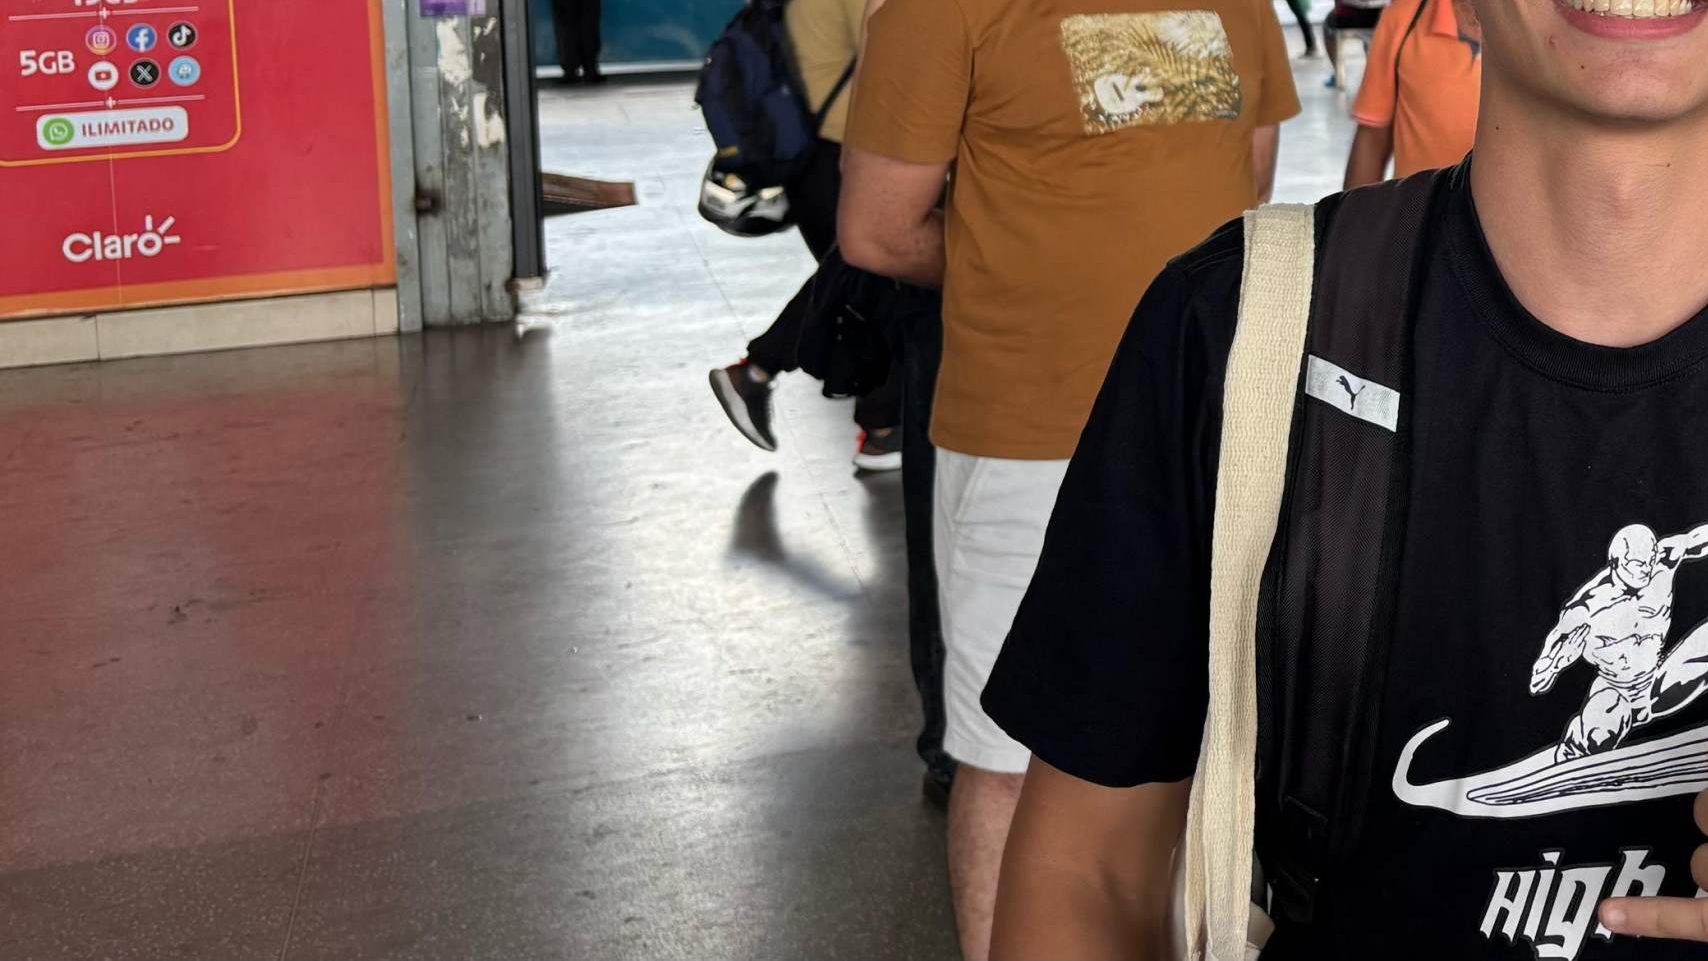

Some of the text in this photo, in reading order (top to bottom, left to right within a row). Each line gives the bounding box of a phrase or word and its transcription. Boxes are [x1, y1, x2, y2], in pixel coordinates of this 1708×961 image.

[19, 49, 76, 77] 5GB
[81, 116, 175, 138] ILIMITADO
[62, 220, 169, 263] Claro
